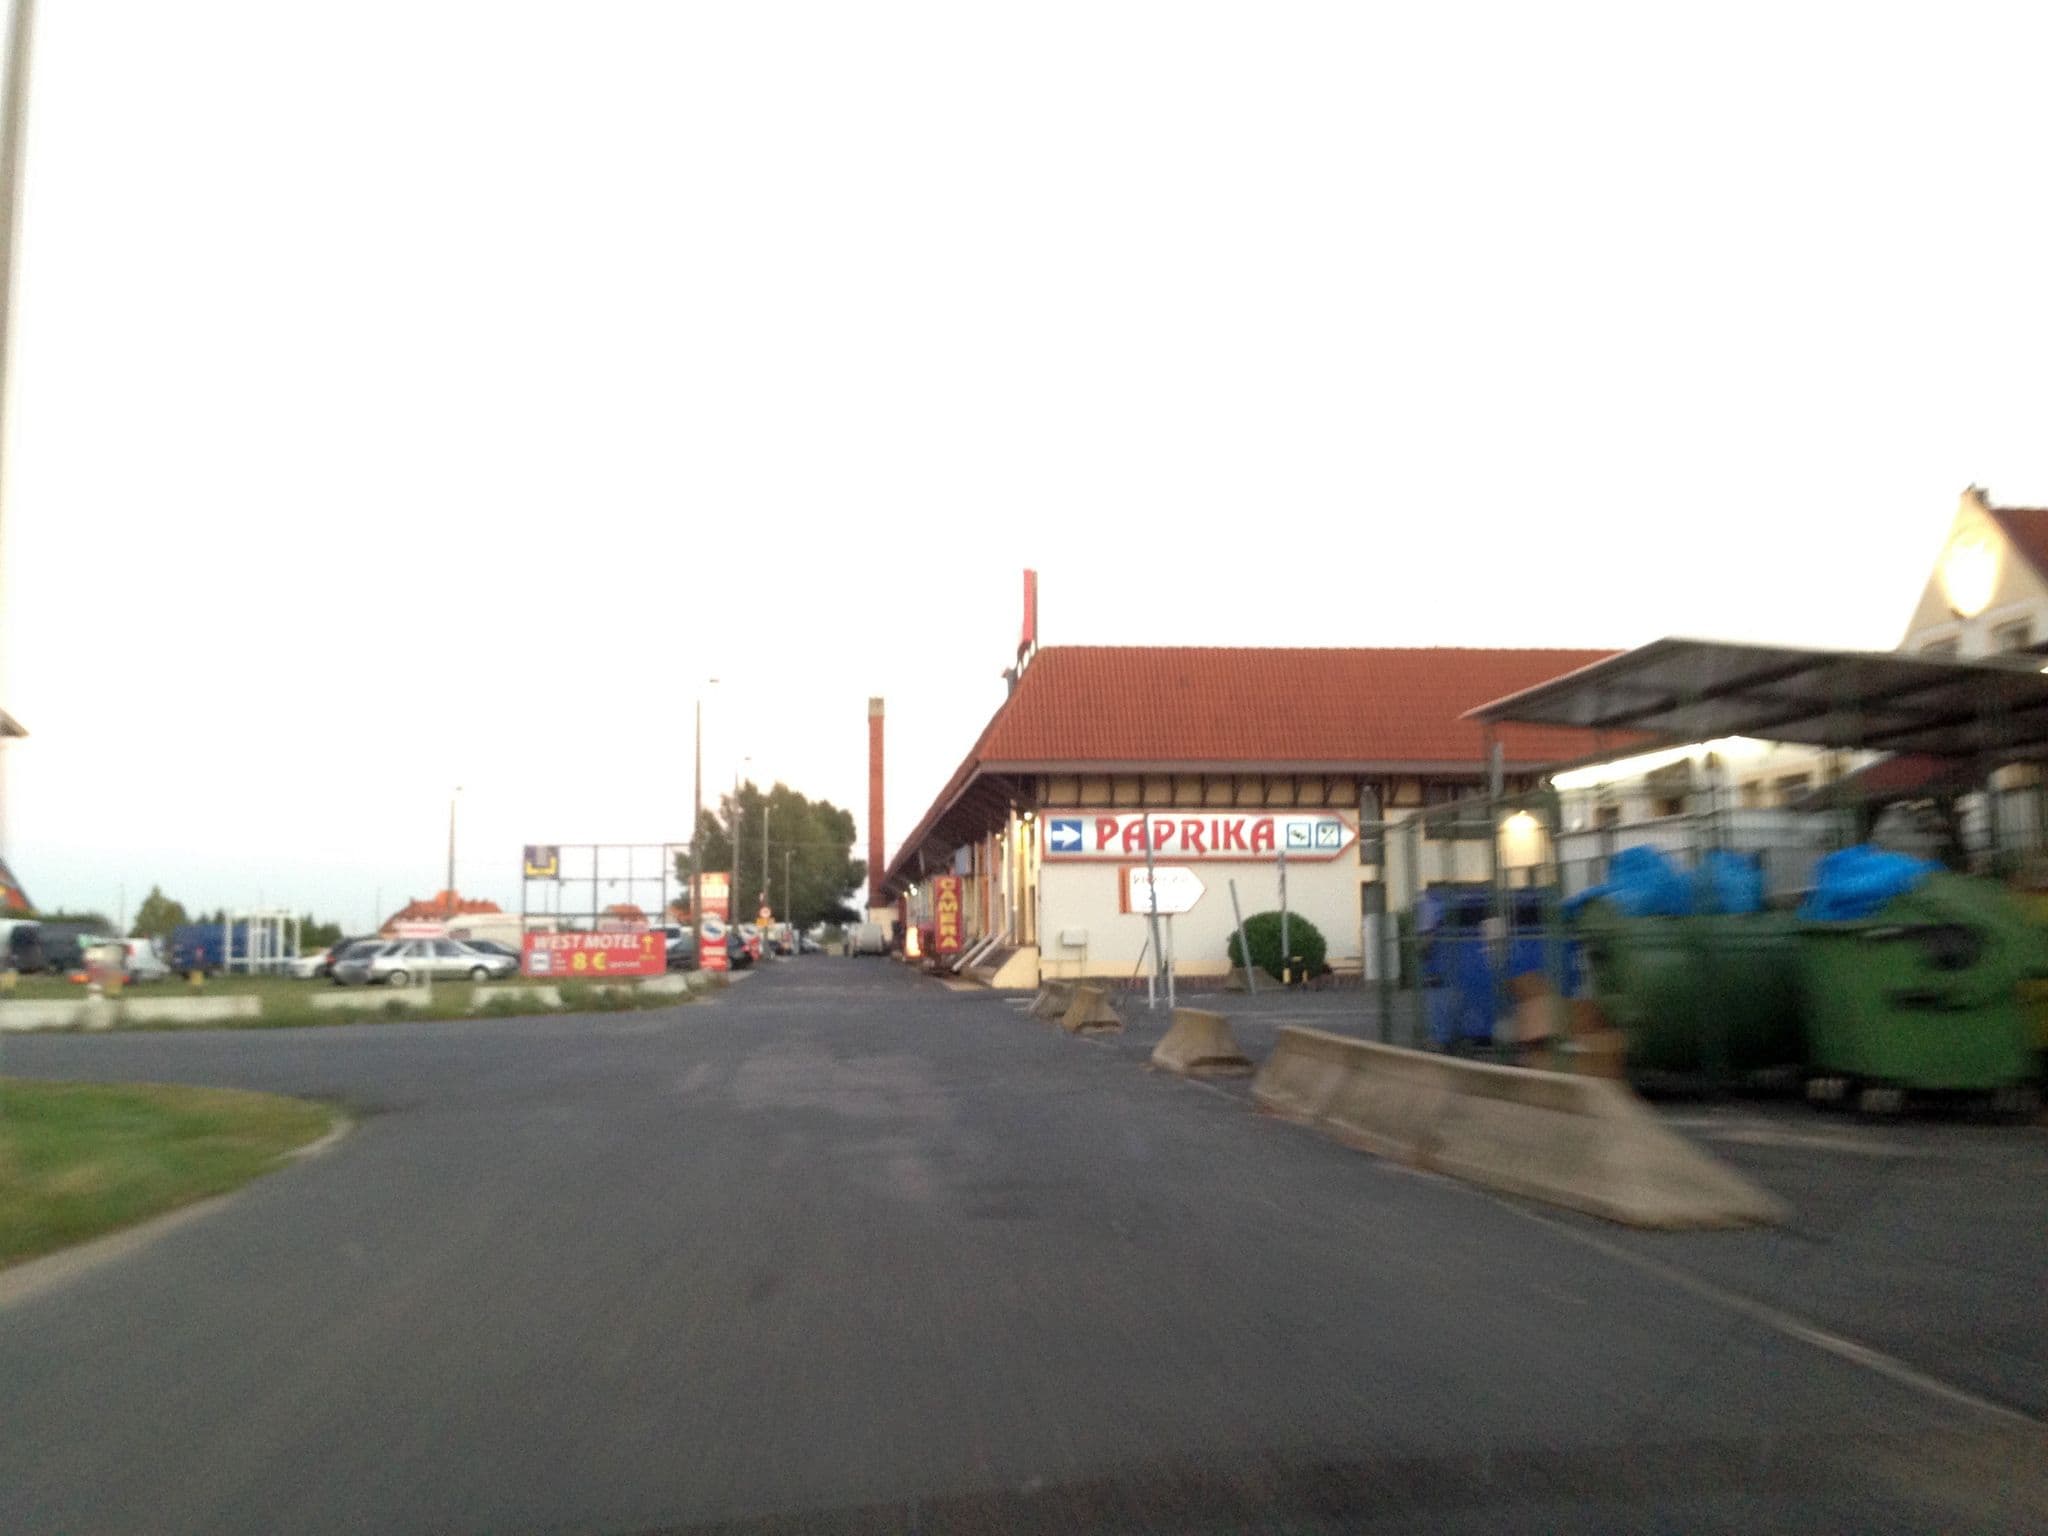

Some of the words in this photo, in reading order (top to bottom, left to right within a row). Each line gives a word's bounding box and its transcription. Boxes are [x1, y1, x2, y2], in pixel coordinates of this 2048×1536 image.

[1095, 817, 1275, 853] PAPRIKA
[534, 934, 583, 950] WEST
[584, 934, 640, 949] MOTEL
[572, 951, 588, 971] 8
[592, 951, 606, 971] €
